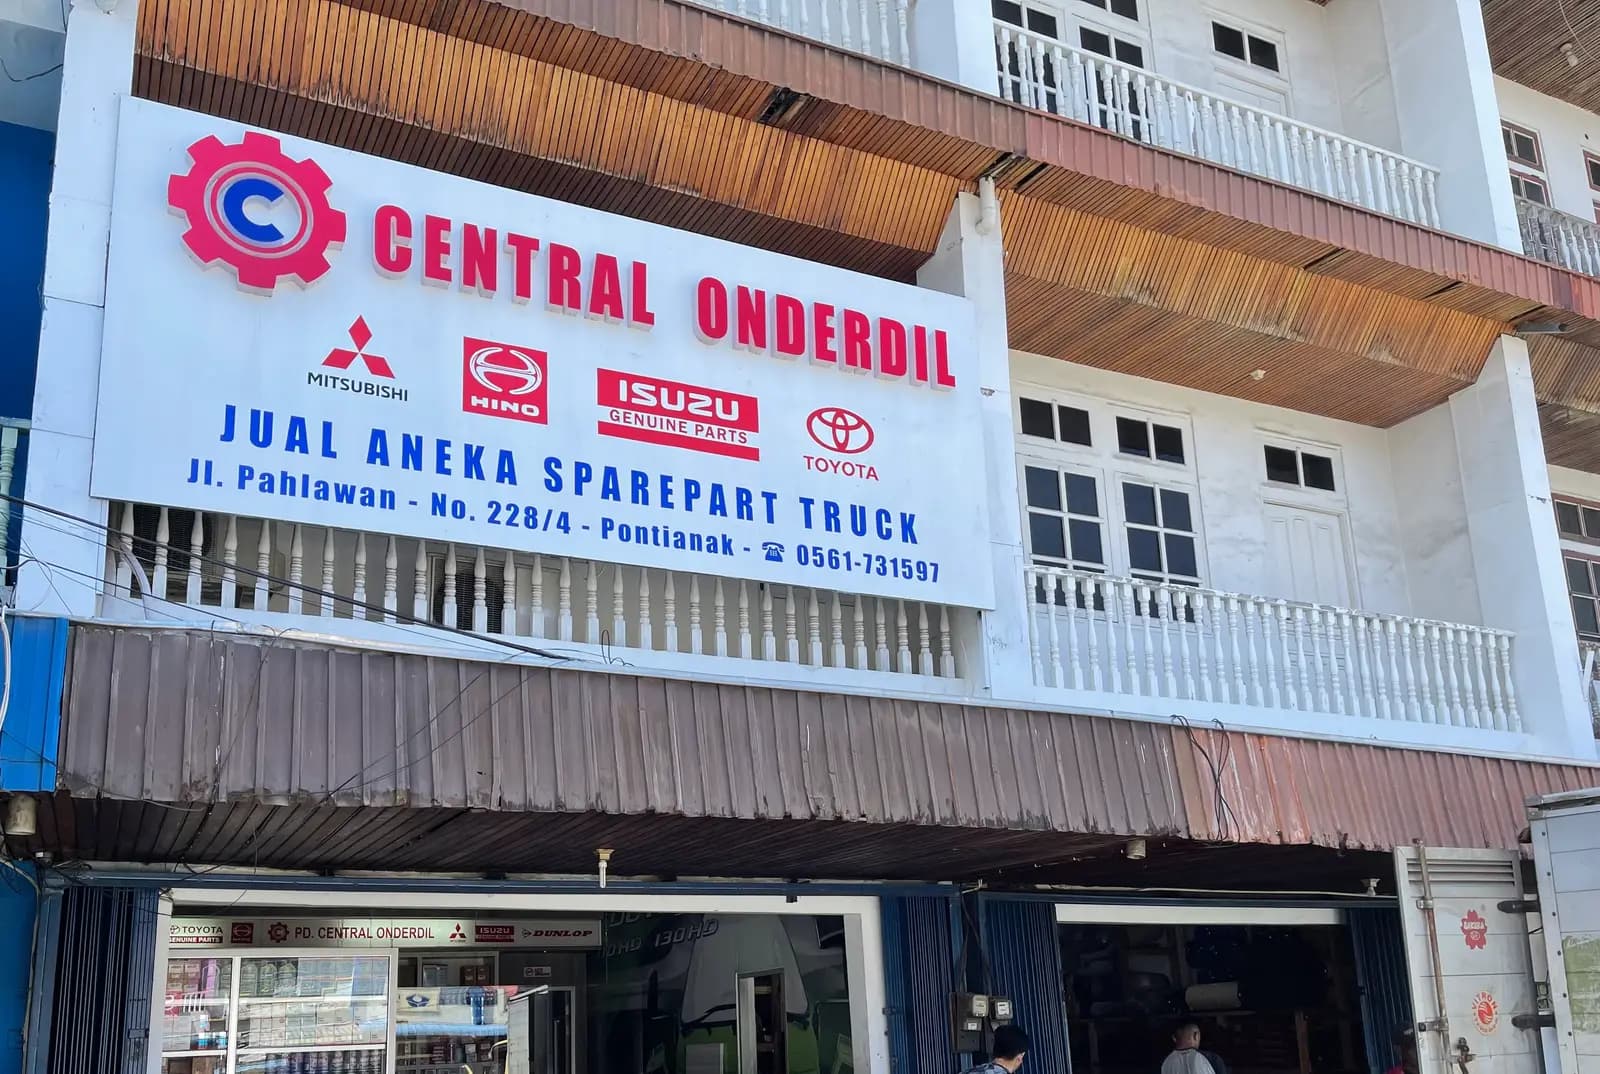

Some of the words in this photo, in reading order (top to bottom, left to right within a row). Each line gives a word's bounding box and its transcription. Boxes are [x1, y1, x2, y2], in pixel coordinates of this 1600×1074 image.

[374, 204, 655, 326] CENTRAL
[696, 276, 956, 387] ONDERDIL
[307, 371, 408, 402] MITSUBISHI
[618, 378, 740, 422] ISUZU
[470, 395, 540, 417] HINO
[609, 408, 688, 434] GENUINE
[694, 424, 749, 445] PARTS
[220, 404, 337, 460] JUAL
[366, 427, 518, 487] ANEKA
[543, 456, 778, 524] SPAREPART
[798, 496, 919, 545] TRUCK
[803, 454, 880, 482] TOYOTA
[187, 457, 223, 488] Jl.
[237, 464, 397, 511] Pahlawan
[431, 491, 476, 522] No.
[487, 500, 572, 535] 228/4
[601, 516, 735, 557] Pontianak
[796, 543, 940, 583] 0561-731597
[182, 926, 224, 935] TOYOTA
[198, 936, 220, 944] PARTS
[294, 927, 314, 939] PD.
[317, 927, 373, 939] CENTRAL
[376, 927, 435, 939] ONDERDIL
[654, 918, 720, 948] 130HD
